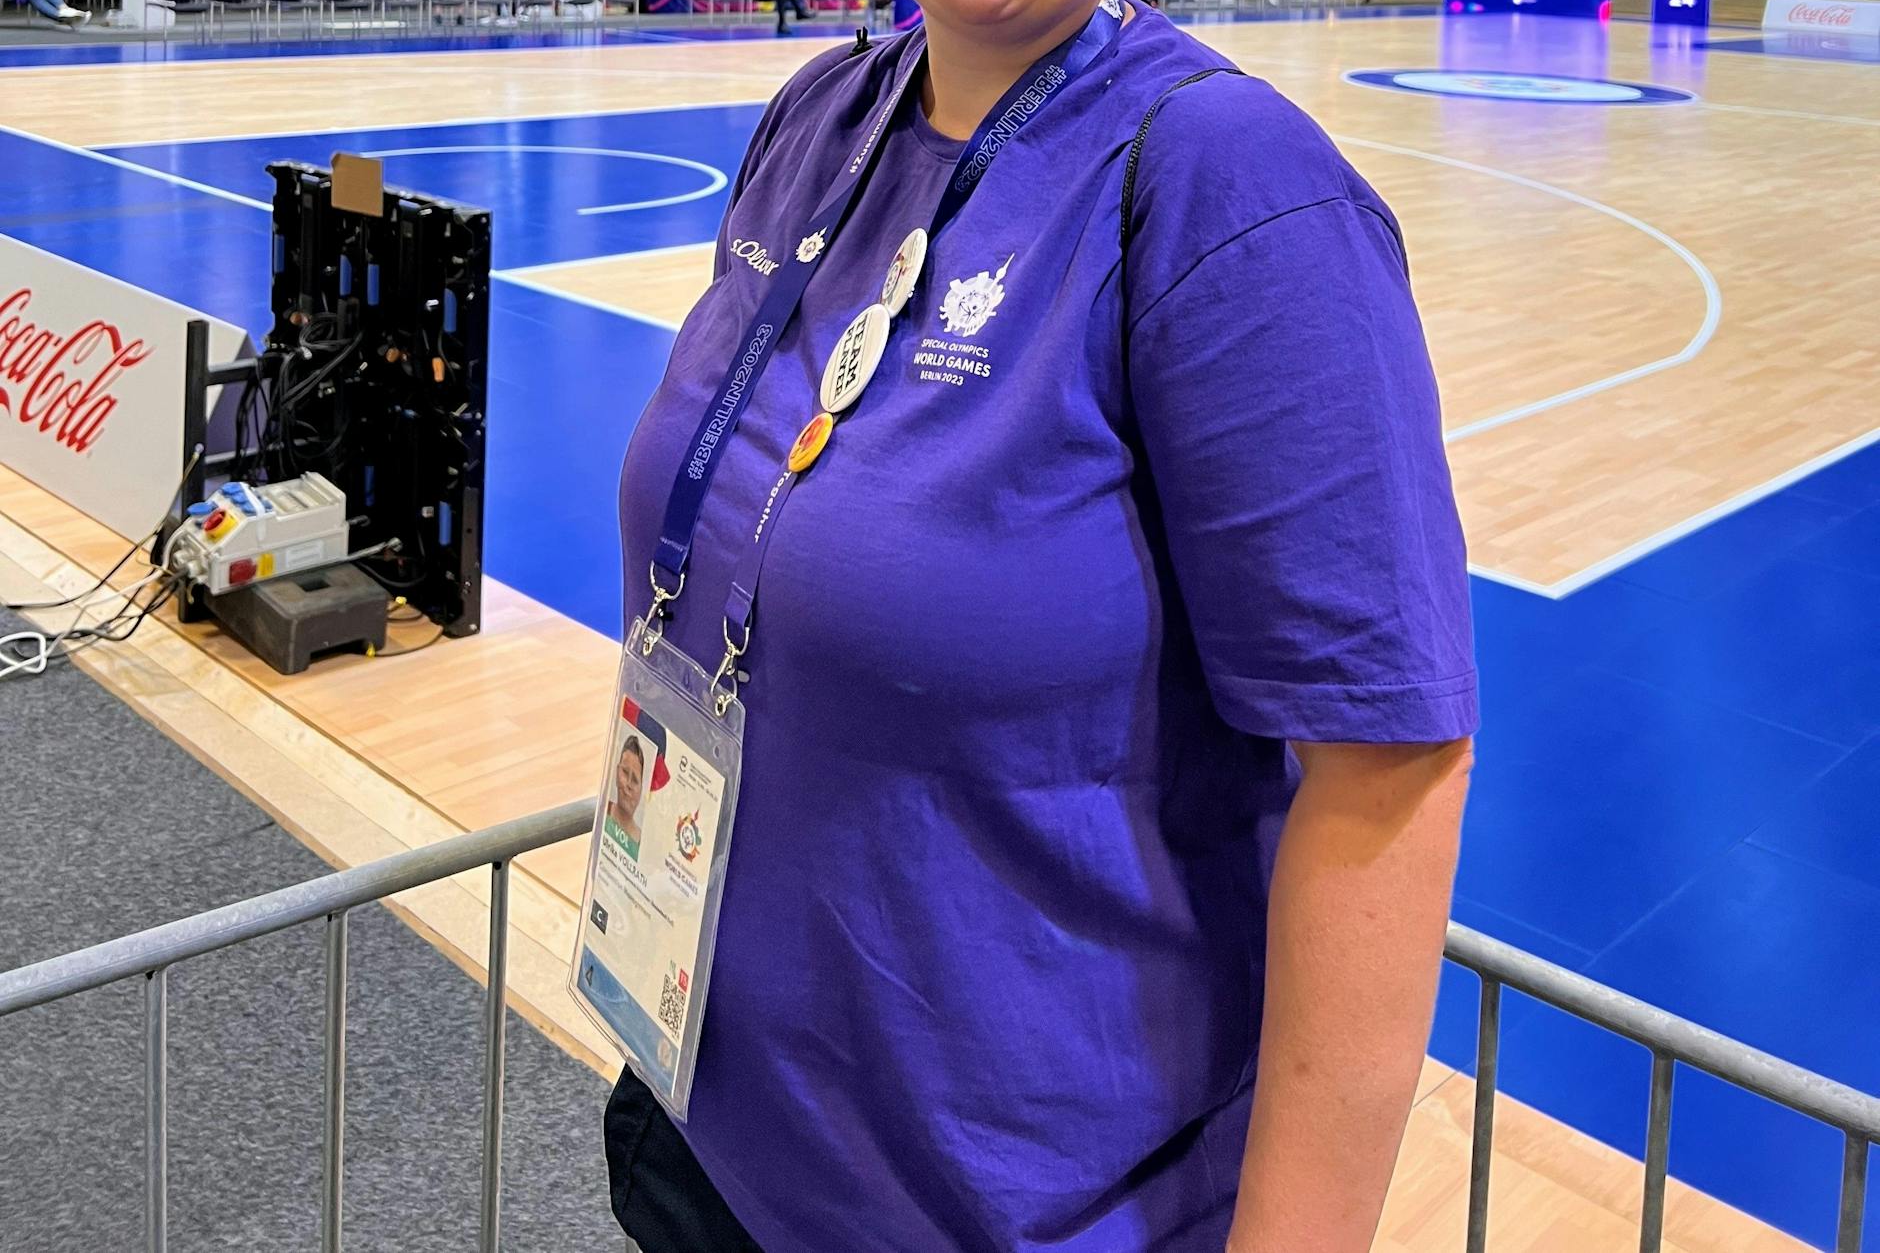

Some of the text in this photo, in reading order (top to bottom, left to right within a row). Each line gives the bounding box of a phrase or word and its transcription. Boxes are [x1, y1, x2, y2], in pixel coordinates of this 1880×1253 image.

[955, 63, 1068, 194] #BERLIN2023
[844, 313, 869, 390] TEAM
[921, 338, 989, 358] SPECIAL OLYMPICS
[913, 352, 991, 377] WORLD GAMES
[920, 370, 964, 386] BERLIN 2023
[687, 323, 774, 481] #BERLIN2023
[614, 824, 630, 848] VOL
